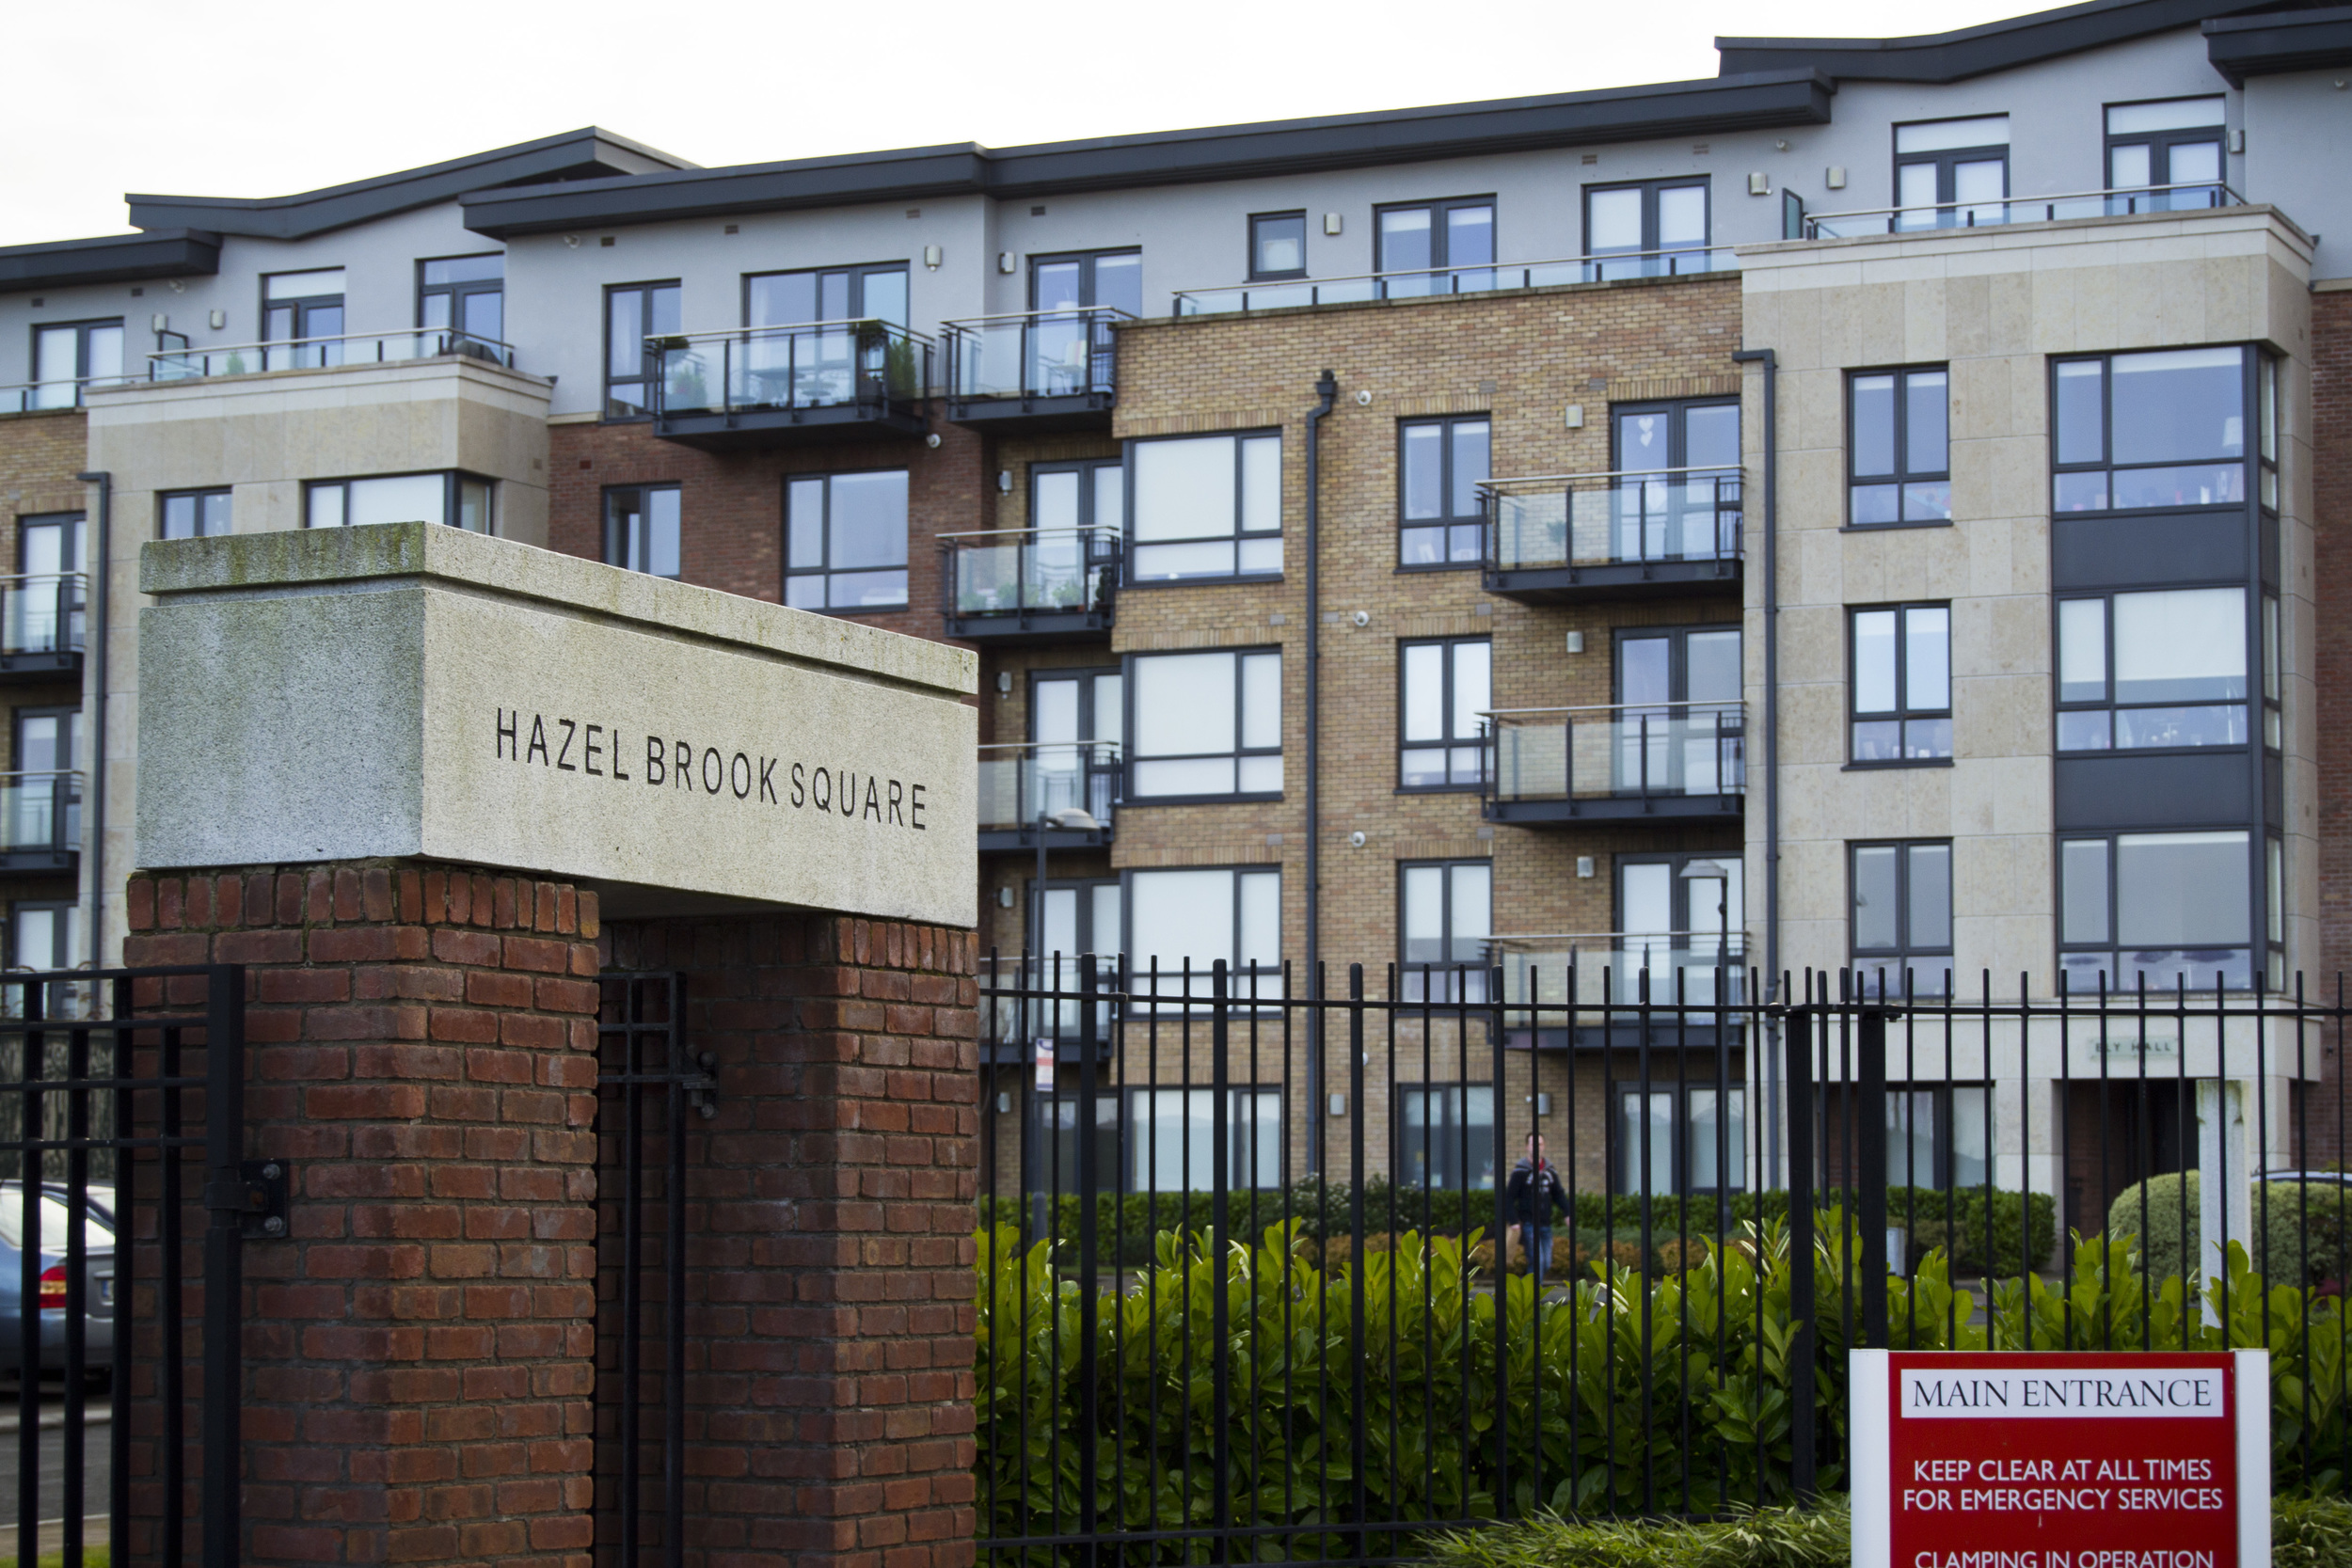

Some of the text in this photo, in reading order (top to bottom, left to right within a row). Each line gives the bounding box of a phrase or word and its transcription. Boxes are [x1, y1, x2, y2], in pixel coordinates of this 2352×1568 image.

[497, 706, 927, 831] HAZEL BROOK SQUARE
[2131, 1042, 2170, 1052] HALL
[1913, 1379, 2212, 1407] MAIN ENTRANCE
[1915, 1459, 2212, 1481] KEEP CLEAR AT ALL TIMES
[1904, 1488, 2223, 1511] FOR EMERGENCY SERVICES
[1915, 1550, 2214, 1568] CLAMPING IN OPERATION
